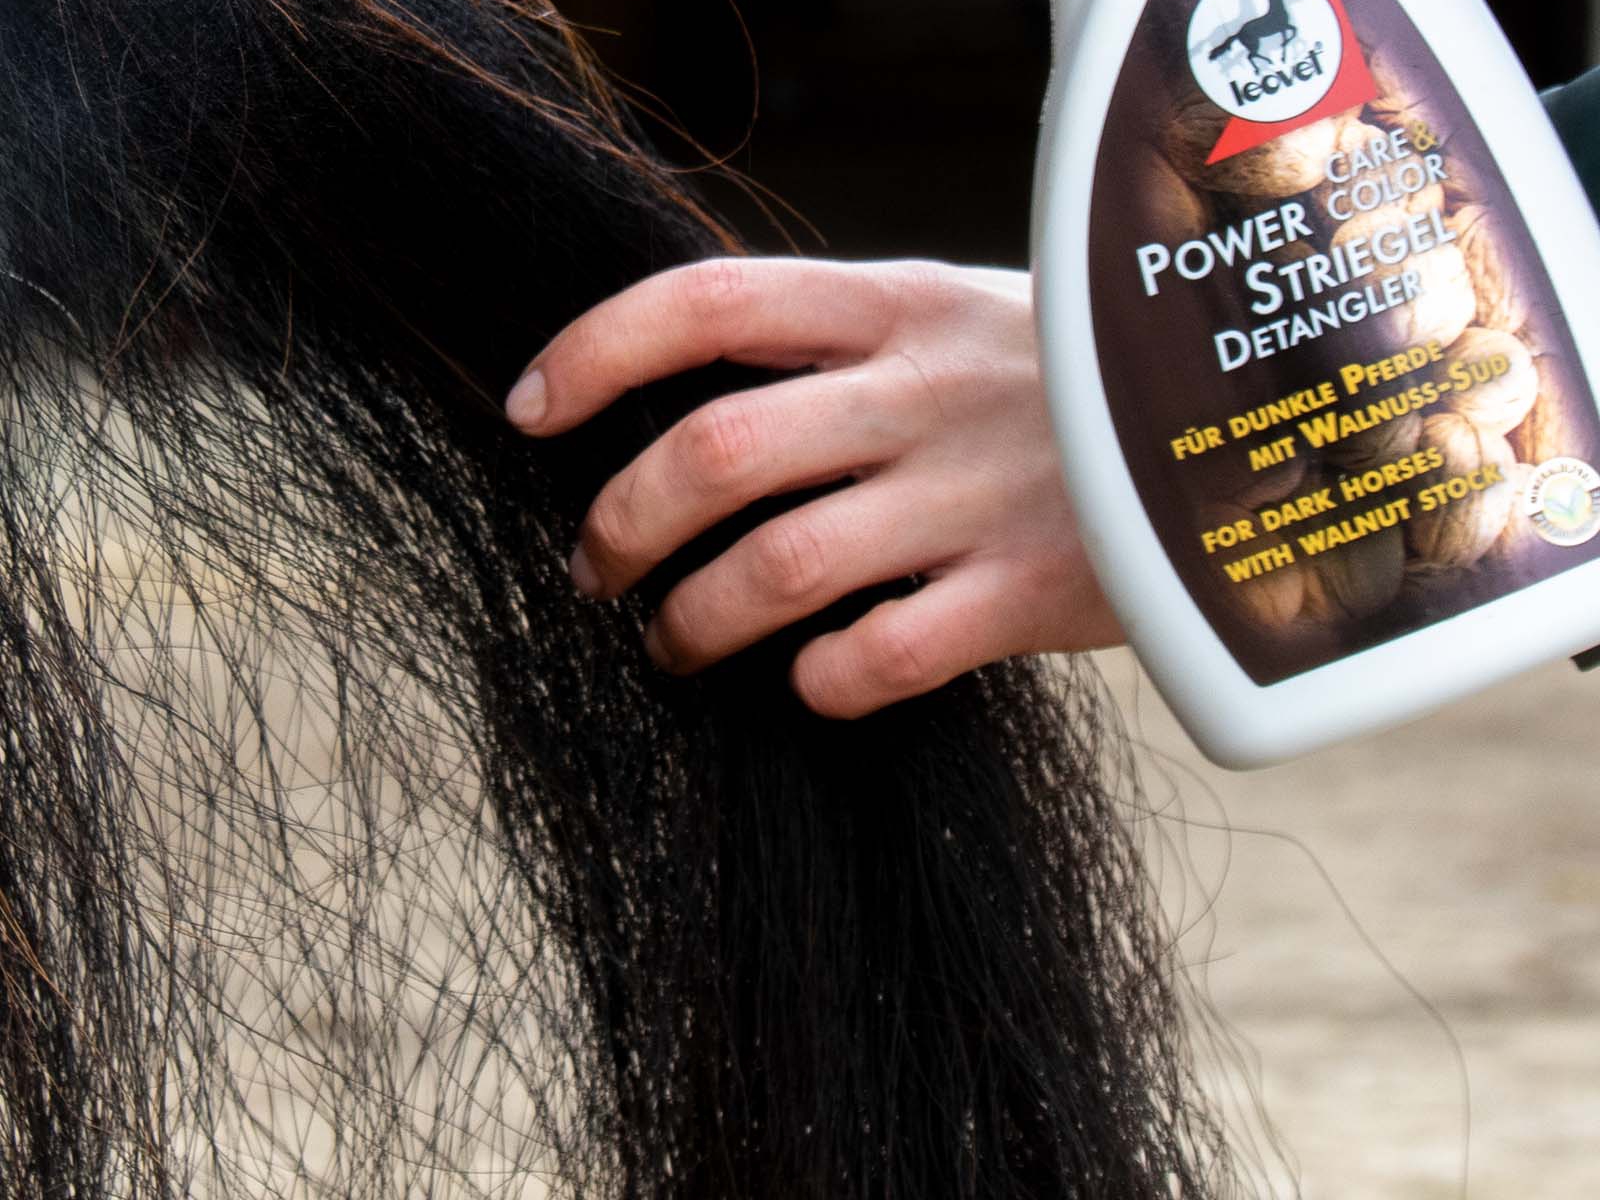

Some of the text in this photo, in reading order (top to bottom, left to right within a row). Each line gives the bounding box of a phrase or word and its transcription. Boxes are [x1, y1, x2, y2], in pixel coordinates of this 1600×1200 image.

[1327, 153, 1448, 221] COLOR
[1136, 202, 1314, 296] POWER
[1245, 207, 1457, 315] STRIEGEL
[1213, 269, 1424, 373] DETANGLER
[1169, 339, 1445, 460] FÜR DUNKLE PFERDE
[1248, 352, 1511, 471] MIT WALNUSS-SUD
[1201, 446, 1445, 554] FOR DARK HORSES
[1223, 543, 1296, 583] WITH
[1297, 498, 1411, 556] WALNUT
[1417, 462, 1505, 511] STOCK
